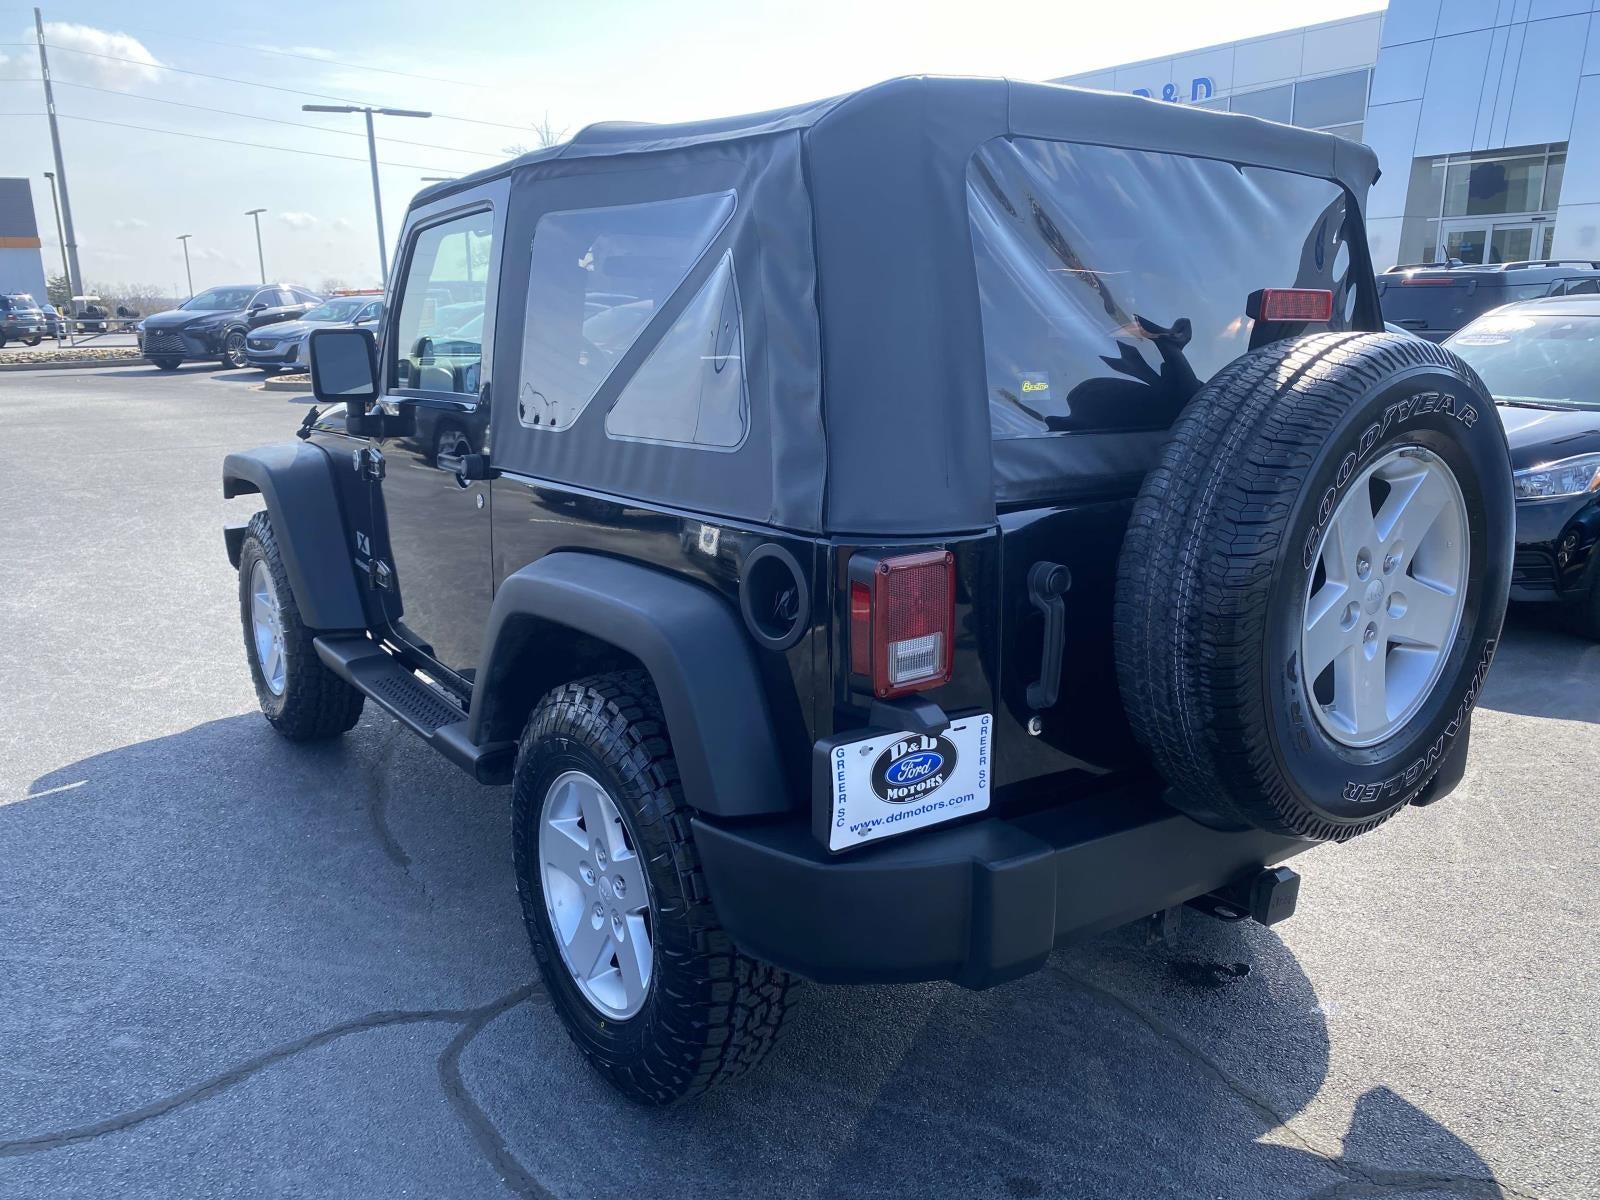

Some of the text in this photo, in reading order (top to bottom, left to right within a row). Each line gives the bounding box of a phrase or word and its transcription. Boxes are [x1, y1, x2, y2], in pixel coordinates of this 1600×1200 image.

[1303, 391, 1479, 570] GOODYEAR
[979, 715, 989, 766] GREER
[1342, 638, 1496, 802] WRANGLER
[889, 735, 938, 762] D&D
[897, 756, 933, 781] Ford
[836, 747, 847, 804] GREER
[886, 773, 943, 801] MOTORS
[849, 793, 975, 832] www.ddmotors.com
